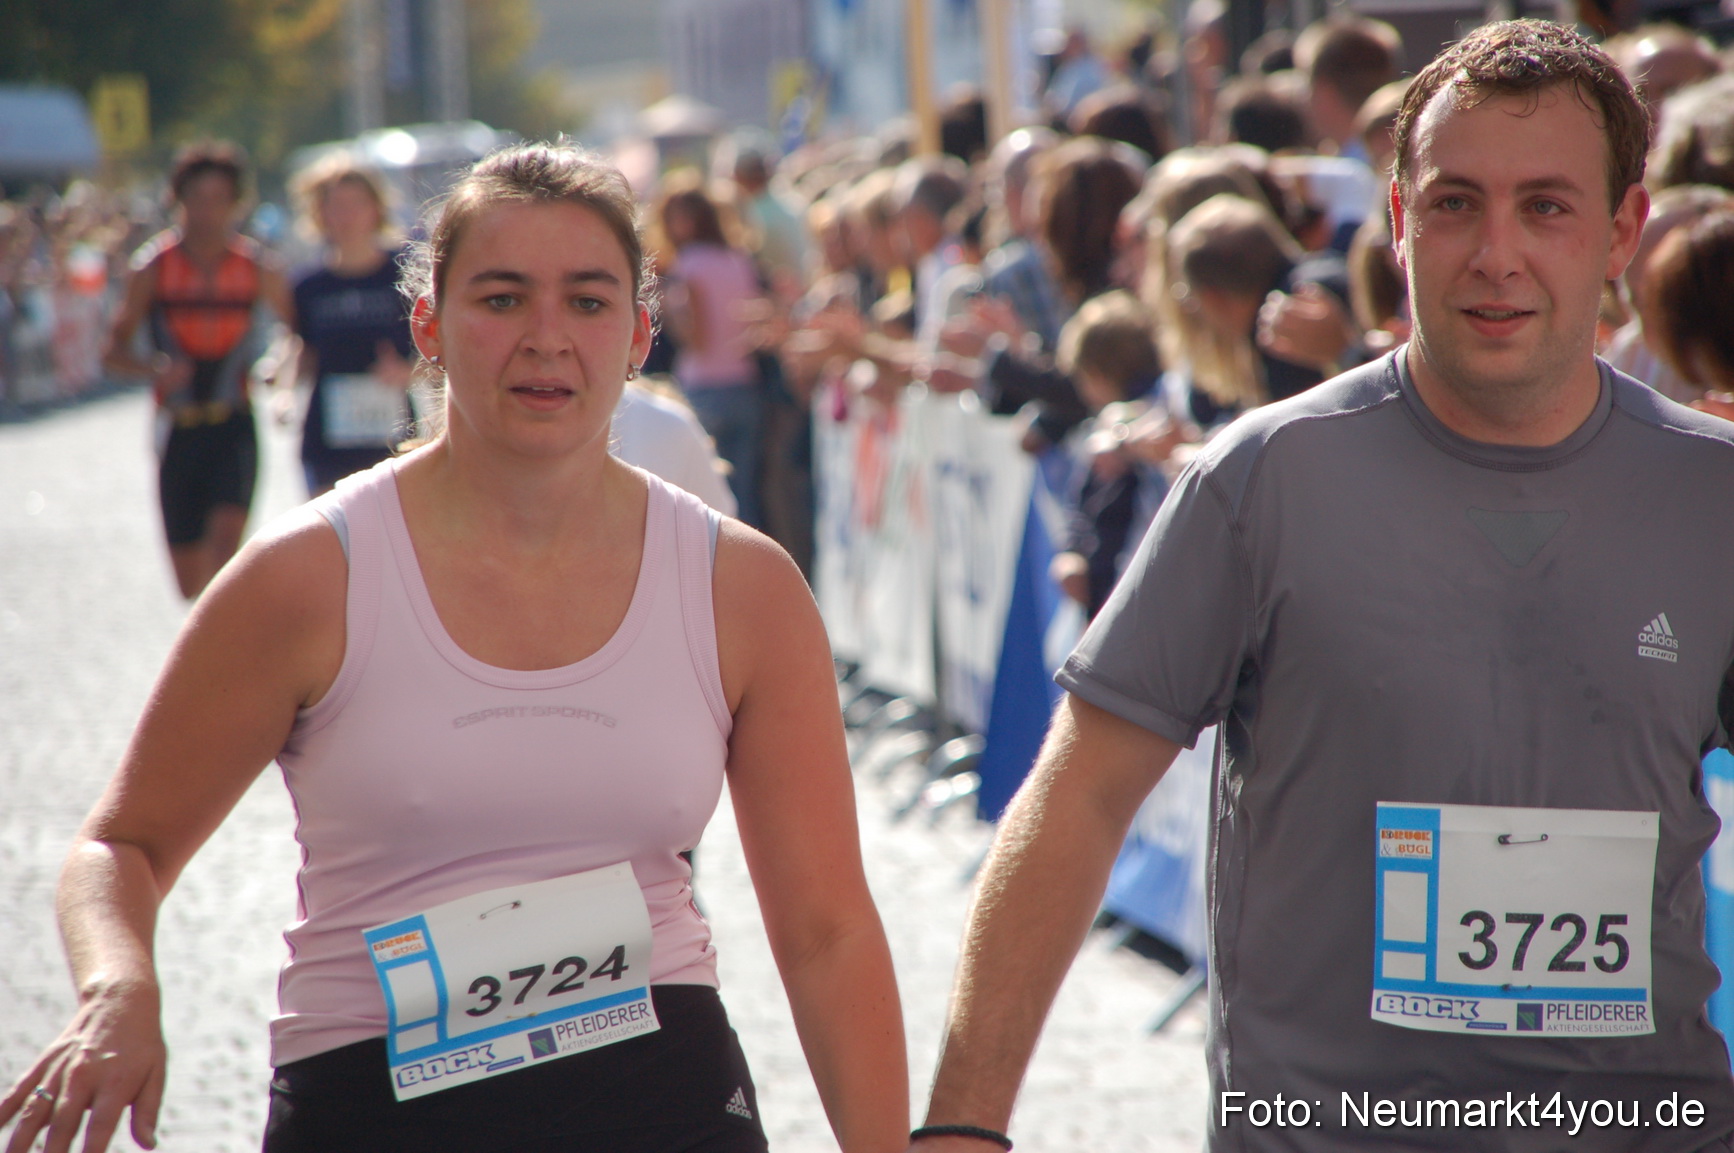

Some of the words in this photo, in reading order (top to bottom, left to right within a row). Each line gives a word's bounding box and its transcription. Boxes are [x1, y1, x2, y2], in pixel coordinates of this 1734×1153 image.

[1638, 631, 1679, 649] adidas
[1458, 910, 1630, 973] 3725
[465, 945, 629, 1017] 3724
[555, 1002, 650, 1041] PFLEIDERER
[1376, 994, 1480, 1020] BOCK
[1547, 1003, 1648, 1021] PFLEIDERER
[561, 1020, 655, 1053] AKTIENGESELLSCHAFT
[1547, 1023, 1649, 1033] AKTIENGESELLSCHAFT
[398, 1043, 496, 1088] BOCK
